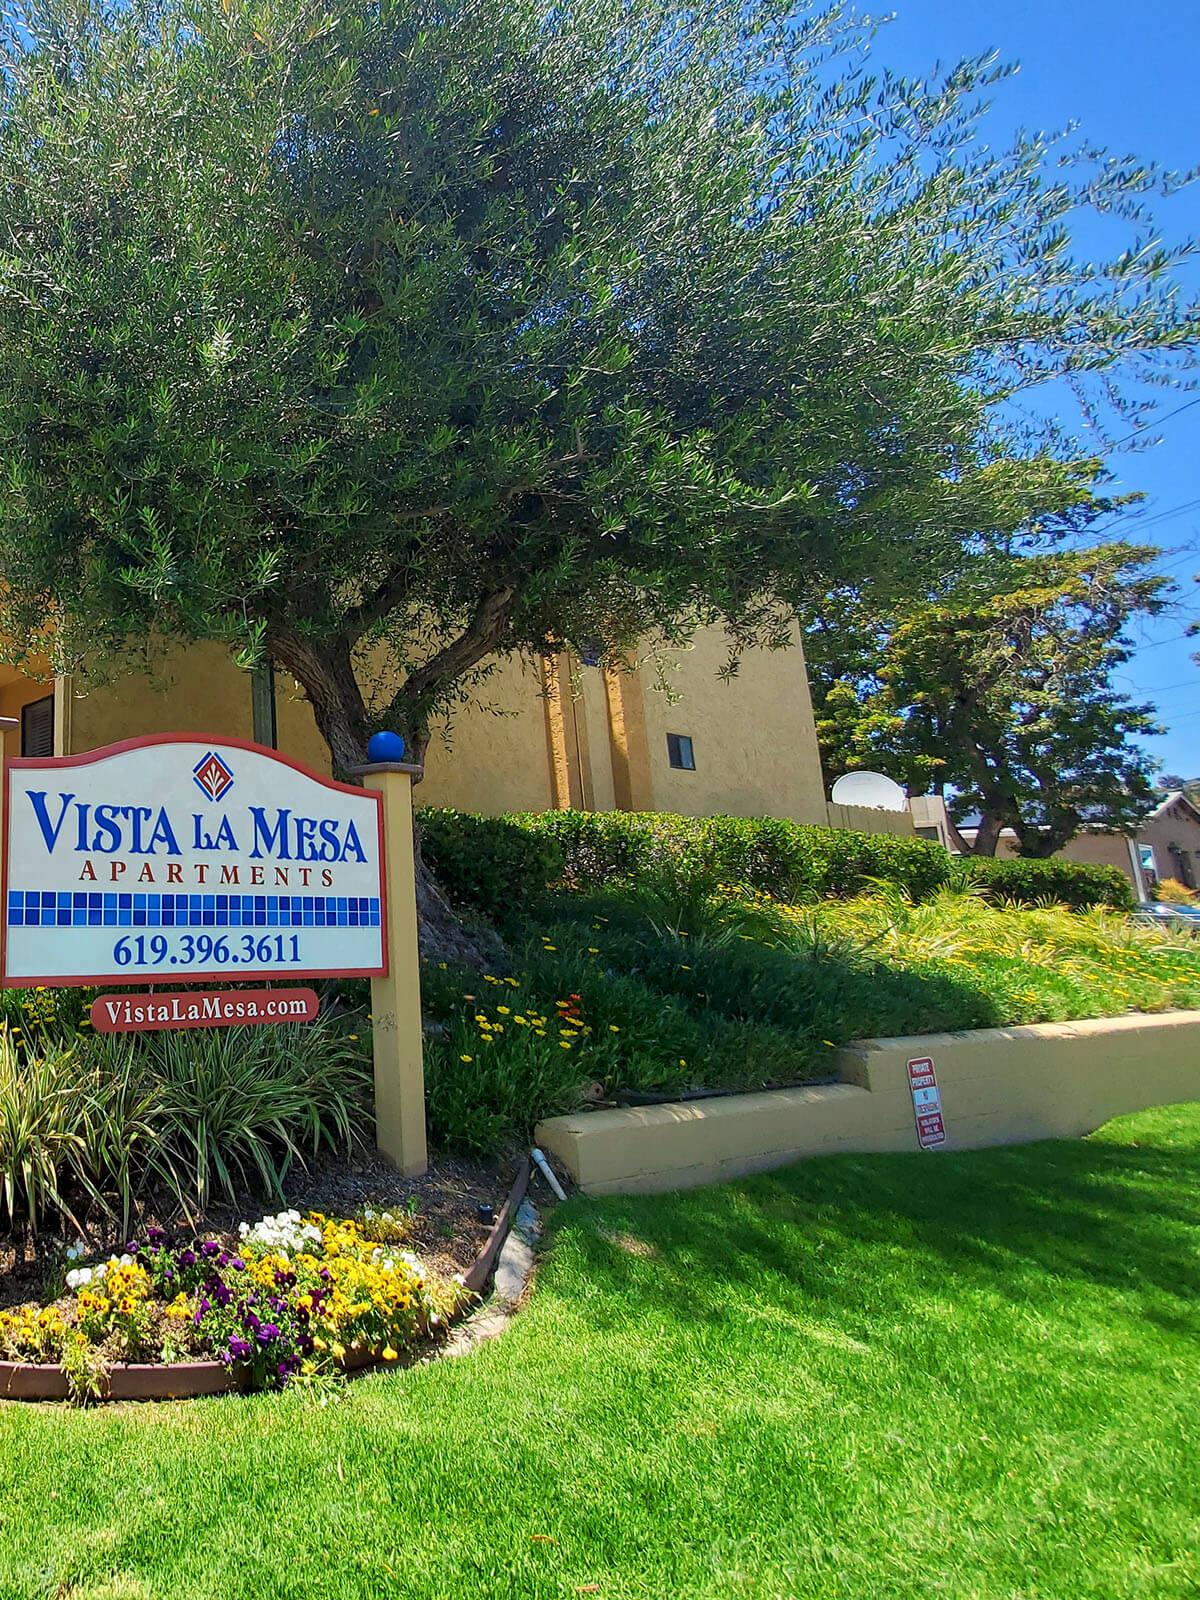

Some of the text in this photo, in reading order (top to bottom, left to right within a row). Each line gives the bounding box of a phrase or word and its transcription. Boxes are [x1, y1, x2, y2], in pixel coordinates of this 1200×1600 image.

[25, 790, 368, 863] VISTA LA MESA
[78, 860, 333, 887] APARTMENTS
[113, 934, 302, 966] 619.396.3611
[105, 997, 308, 1024] VistaLaMesa.com
